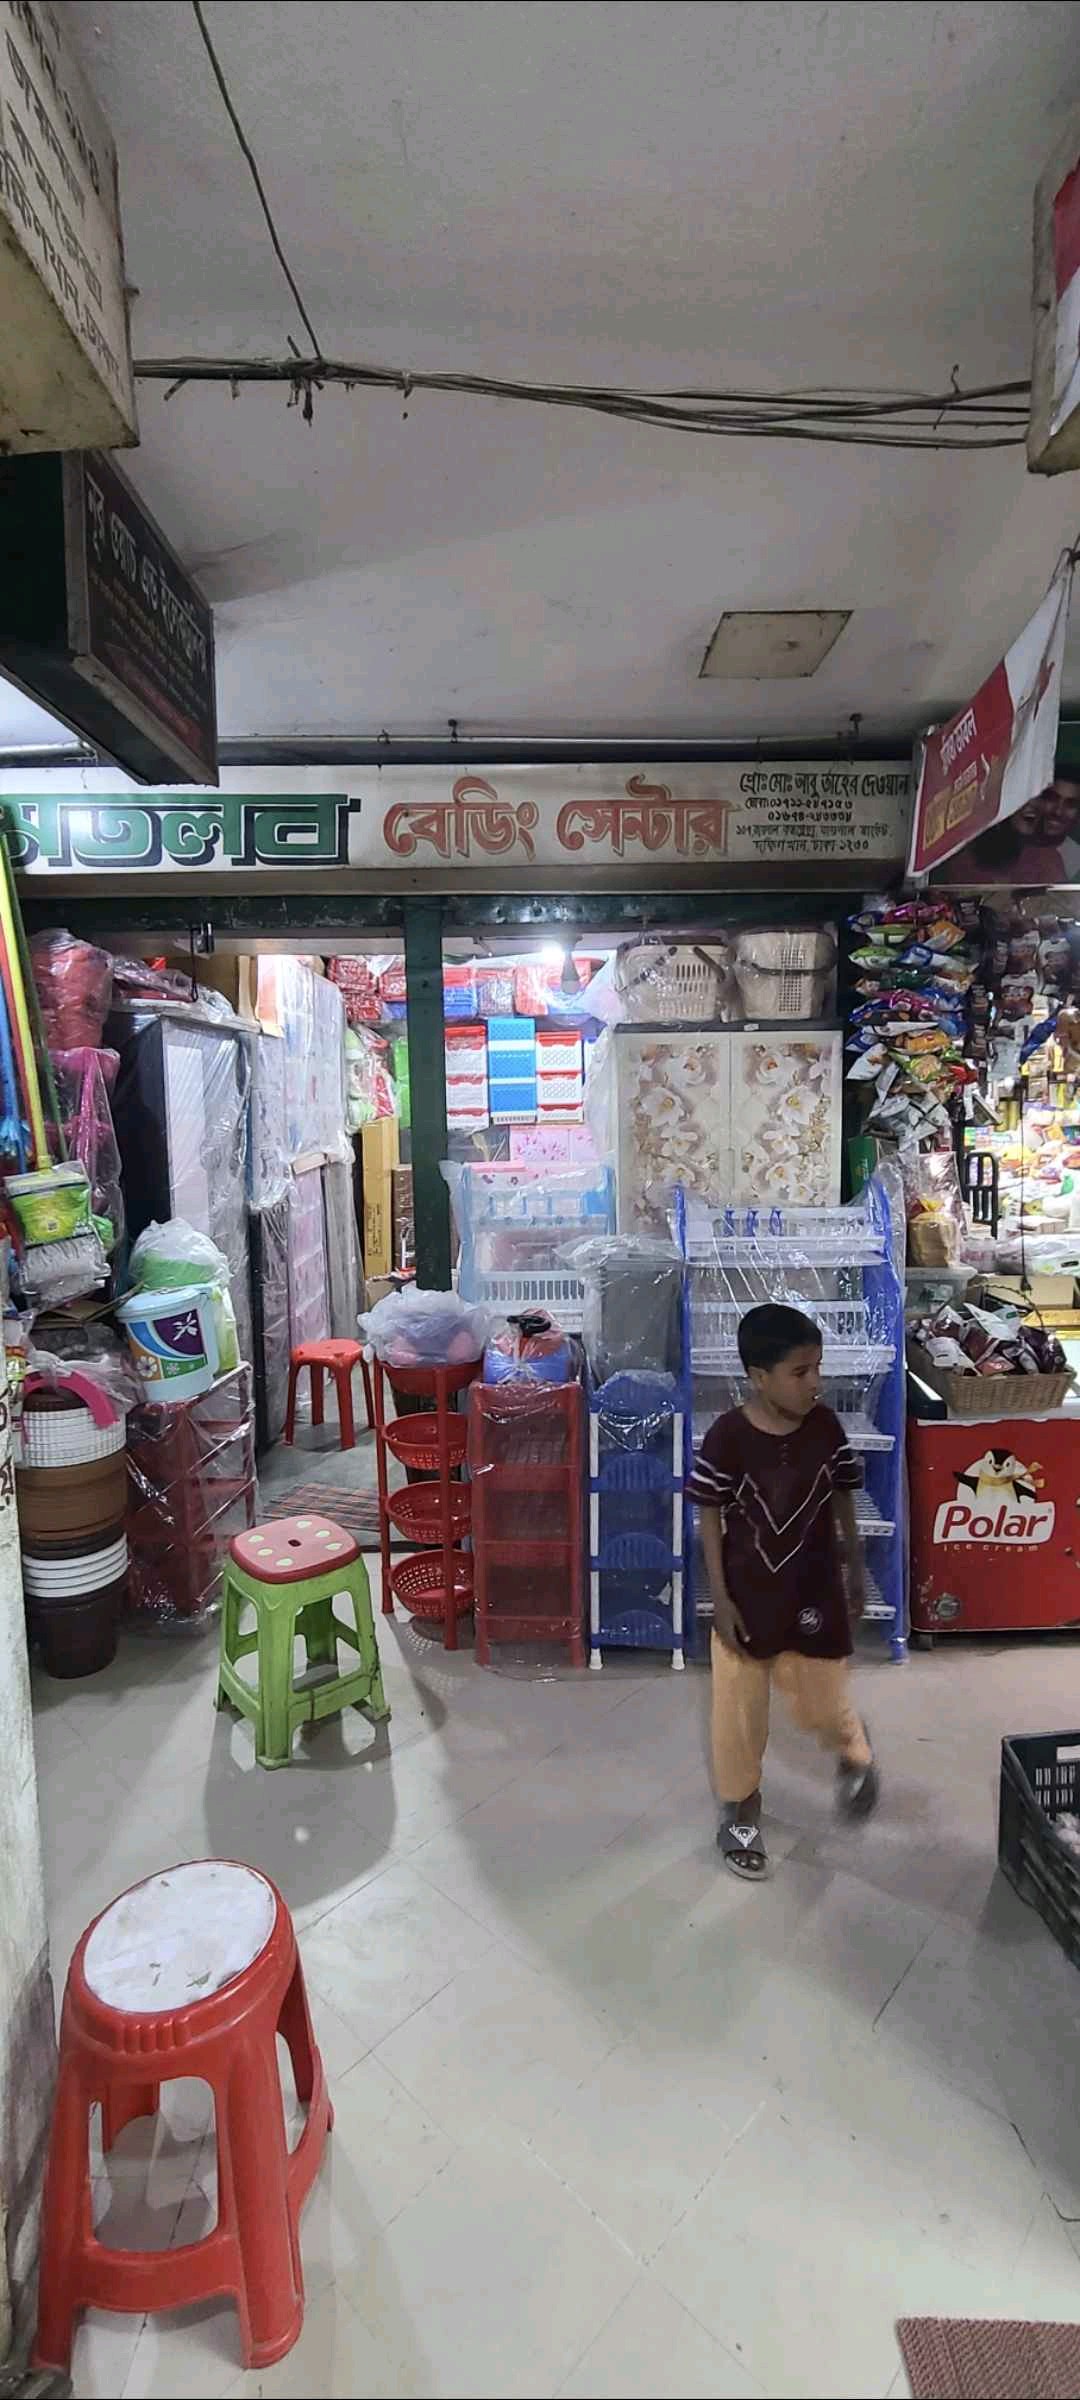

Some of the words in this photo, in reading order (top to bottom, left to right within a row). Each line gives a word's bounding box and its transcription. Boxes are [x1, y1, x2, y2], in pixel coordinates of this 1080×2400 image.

[0, 793, 361, 867] মতলব
[384, 775, 540, 862] বেডিং
[556, 773, 731, 857] সেন্টার
[942, 1505, 1048, 1538] Polar
[943, 1543, 972, 1551] ice
[983, 1543, 1038, 1552] cream
